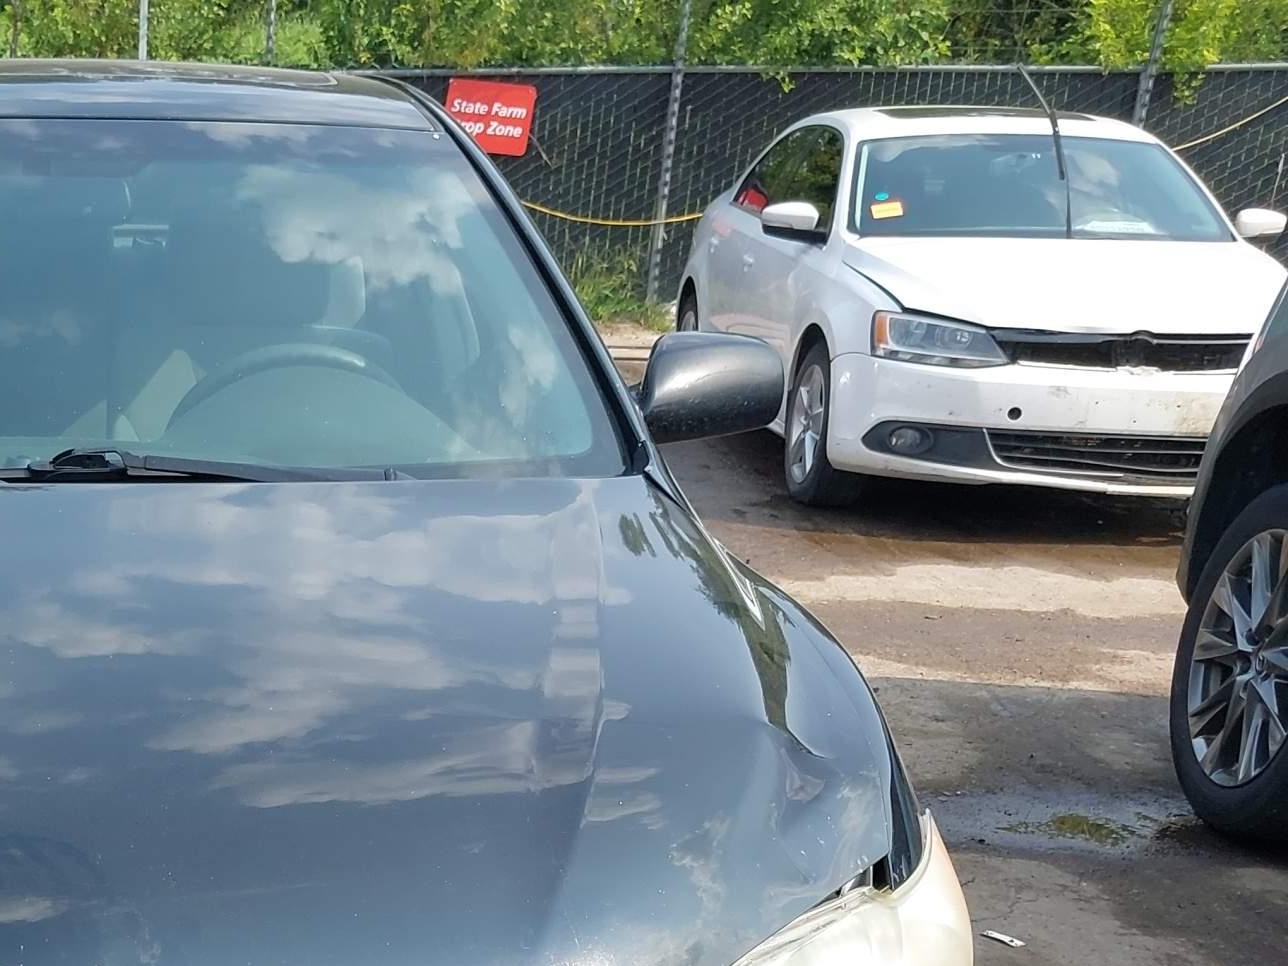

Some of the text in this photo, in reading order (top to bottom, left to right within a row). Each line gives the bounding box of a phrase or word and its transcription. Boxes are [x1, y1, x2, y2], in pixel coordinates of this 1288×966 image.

[450, 98, 527, 120] State Farm
[456, 119, 523, 138] rop Zone
